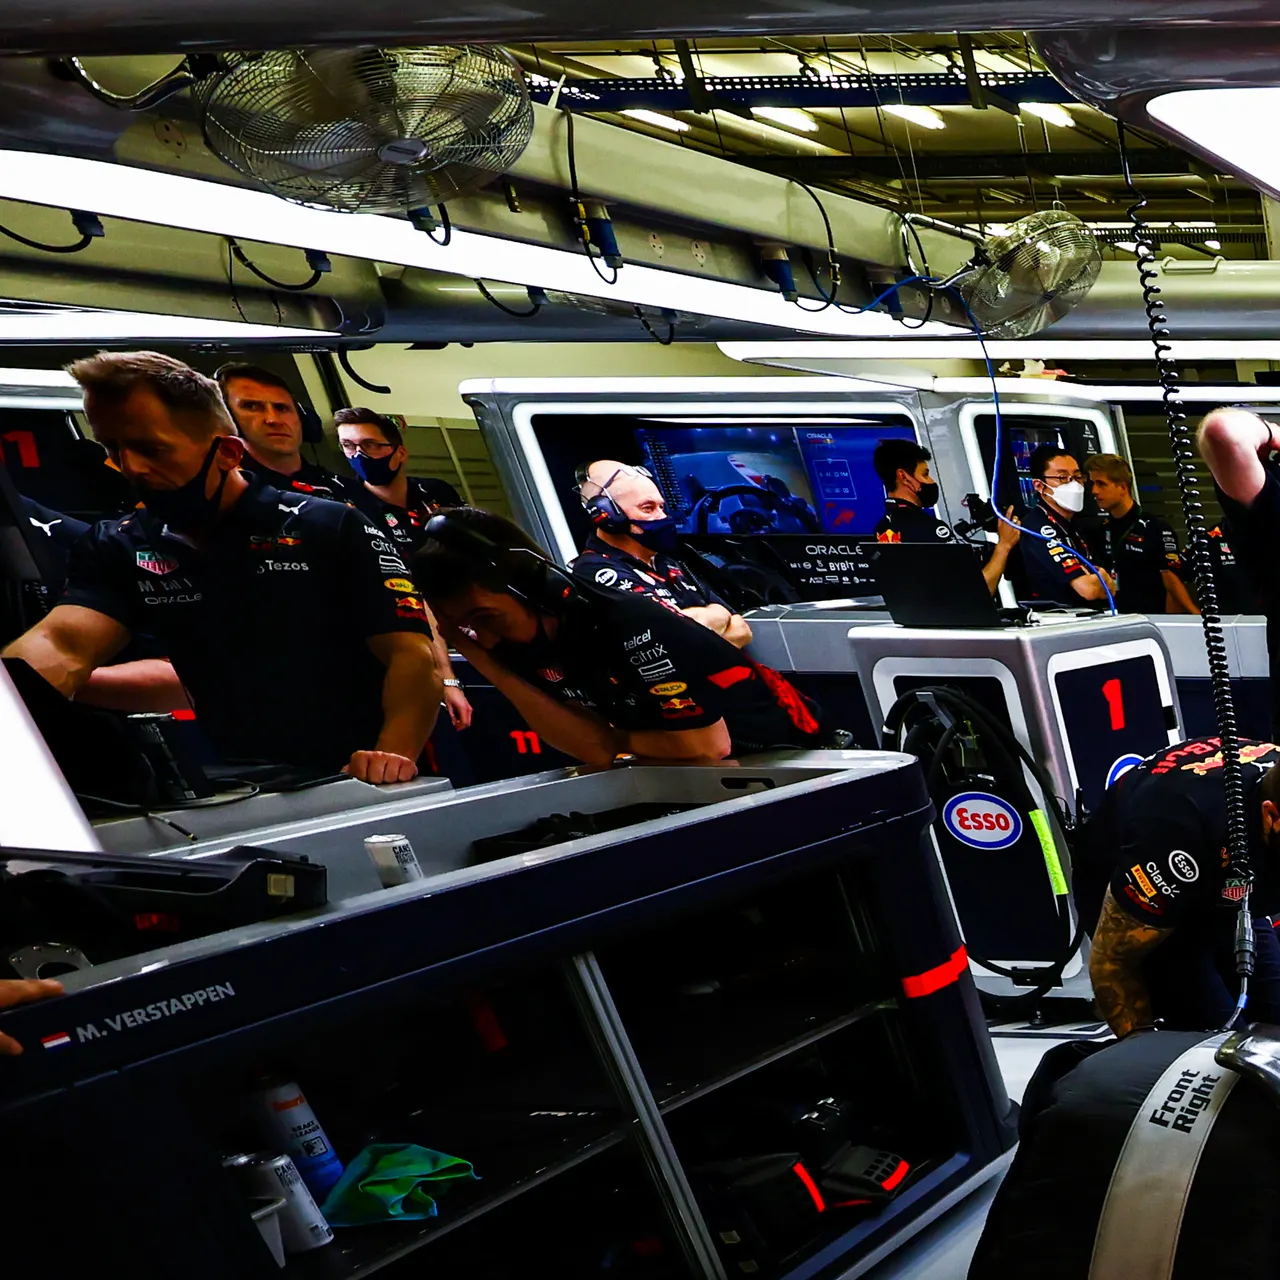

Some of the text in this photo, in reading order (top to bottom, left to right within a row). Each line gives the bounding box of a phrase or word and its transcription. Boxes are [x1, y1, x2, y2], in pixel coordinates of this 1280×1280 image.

[805, 545, 864, 555] ORACLE
[265, 560, 309, 572] Tezos
[829, 560, 855, 572] BYBIT
[624, 629, 651, 650] telcel
[630, 643, 668, 666] citrix
[1102, 678, 1126, 731] 1
[510, 730, 541, 754] 11
[956, 808, 1010, 831] Esso
[1174, 854, 1195, 880] Esso
[1146, 862, 1180, 898] Claro
[1149, 1069, 1200, 1128] Front
[1172, 1074, 1221, 1134] Right
